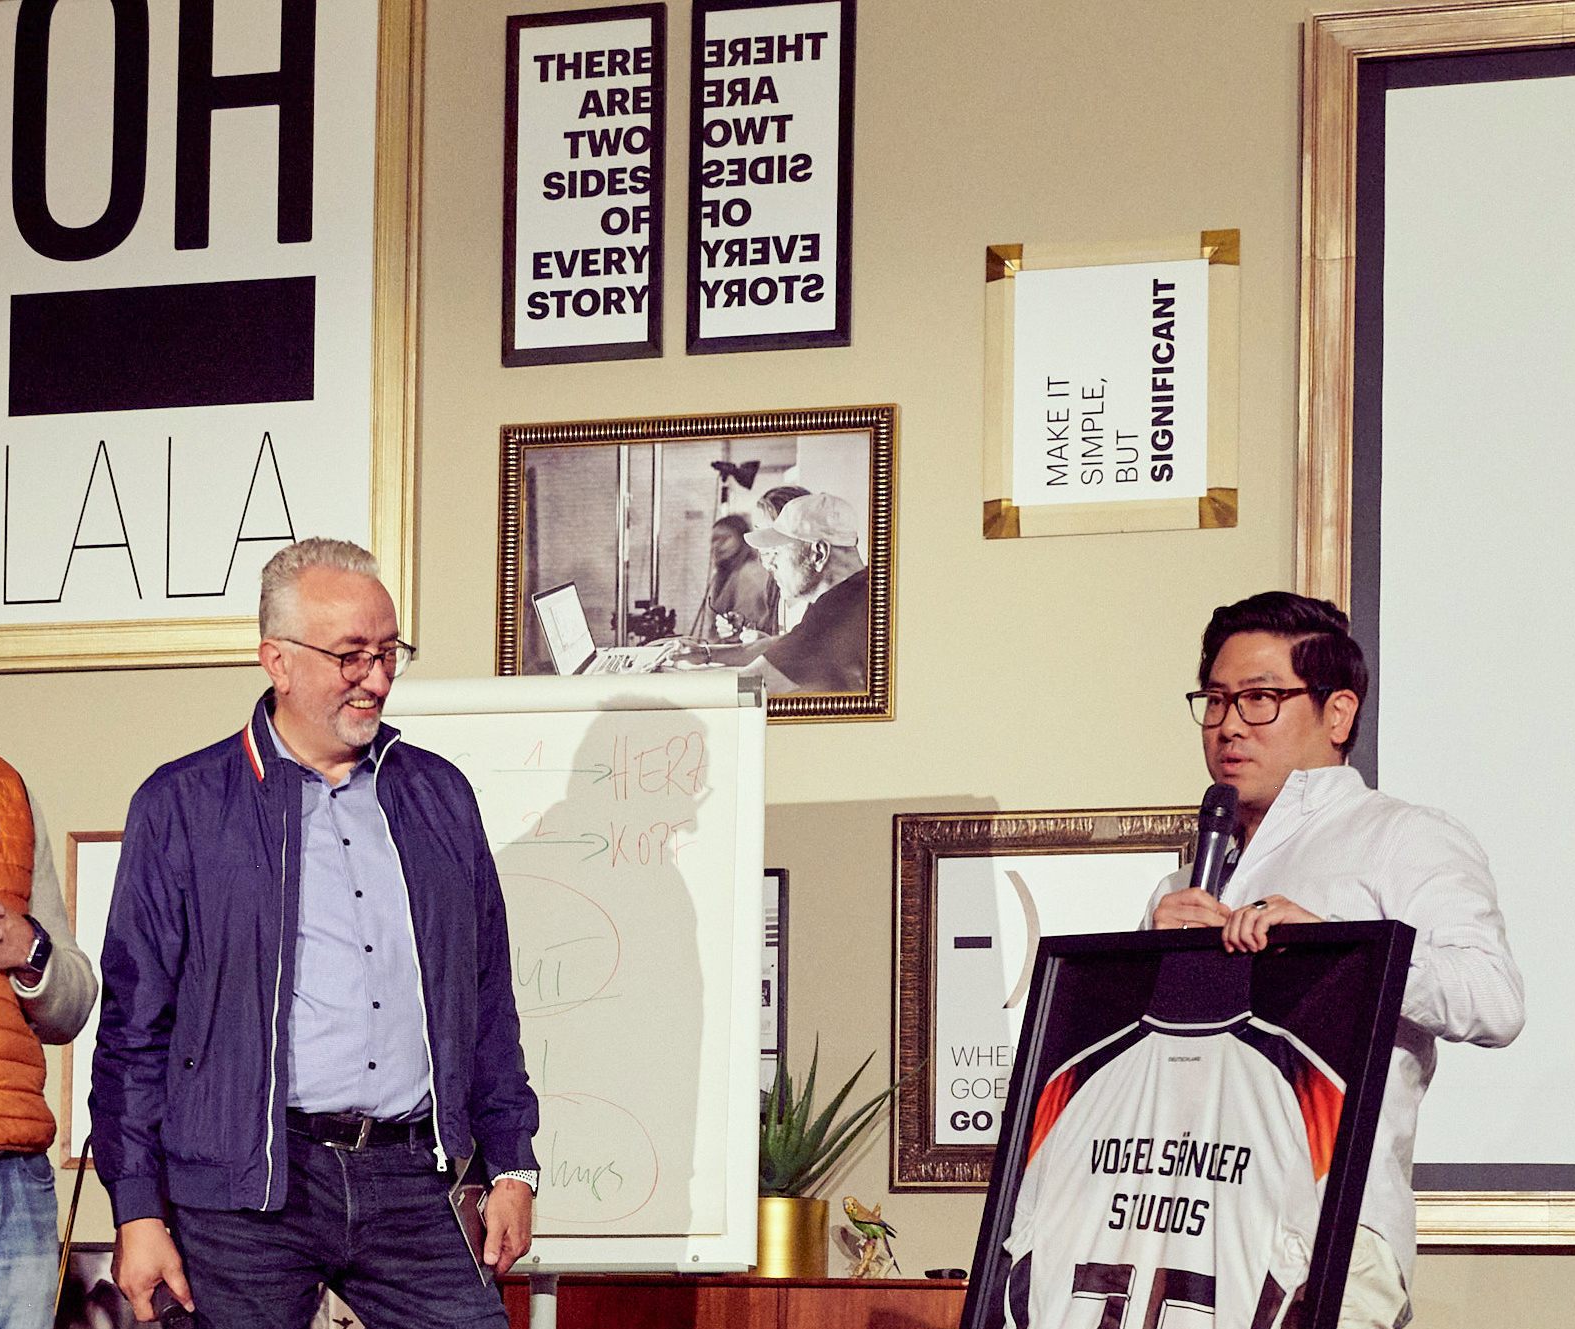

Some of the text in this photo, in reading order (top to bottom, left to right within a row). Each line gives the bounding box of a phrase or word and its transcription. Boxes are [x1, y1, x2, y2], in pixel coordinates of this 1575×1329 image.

[534, 46, 652, 83] THERE
[578, 86, 652, 119] ARE
[12, 0, 316, 262] OH
[564, 126, 652, 159] TWO
[543, 166, 652, 200] SIDES
[601, 206, 651, 235] OF
[532, 245, 649, 280] EVERY
[527, 285, 649, 320] STORY
[1150, 279, 1175, 482] SIGNIFICANT
[1046, 376, 1070, 486] MAKE IT
[1081, 378, 1108, 485] SIMPLE,
[1115, 429, 1139, 483] BUT
[610, 820, 697, 868] KOPF
[950, 1110, 993, 1132] GO
